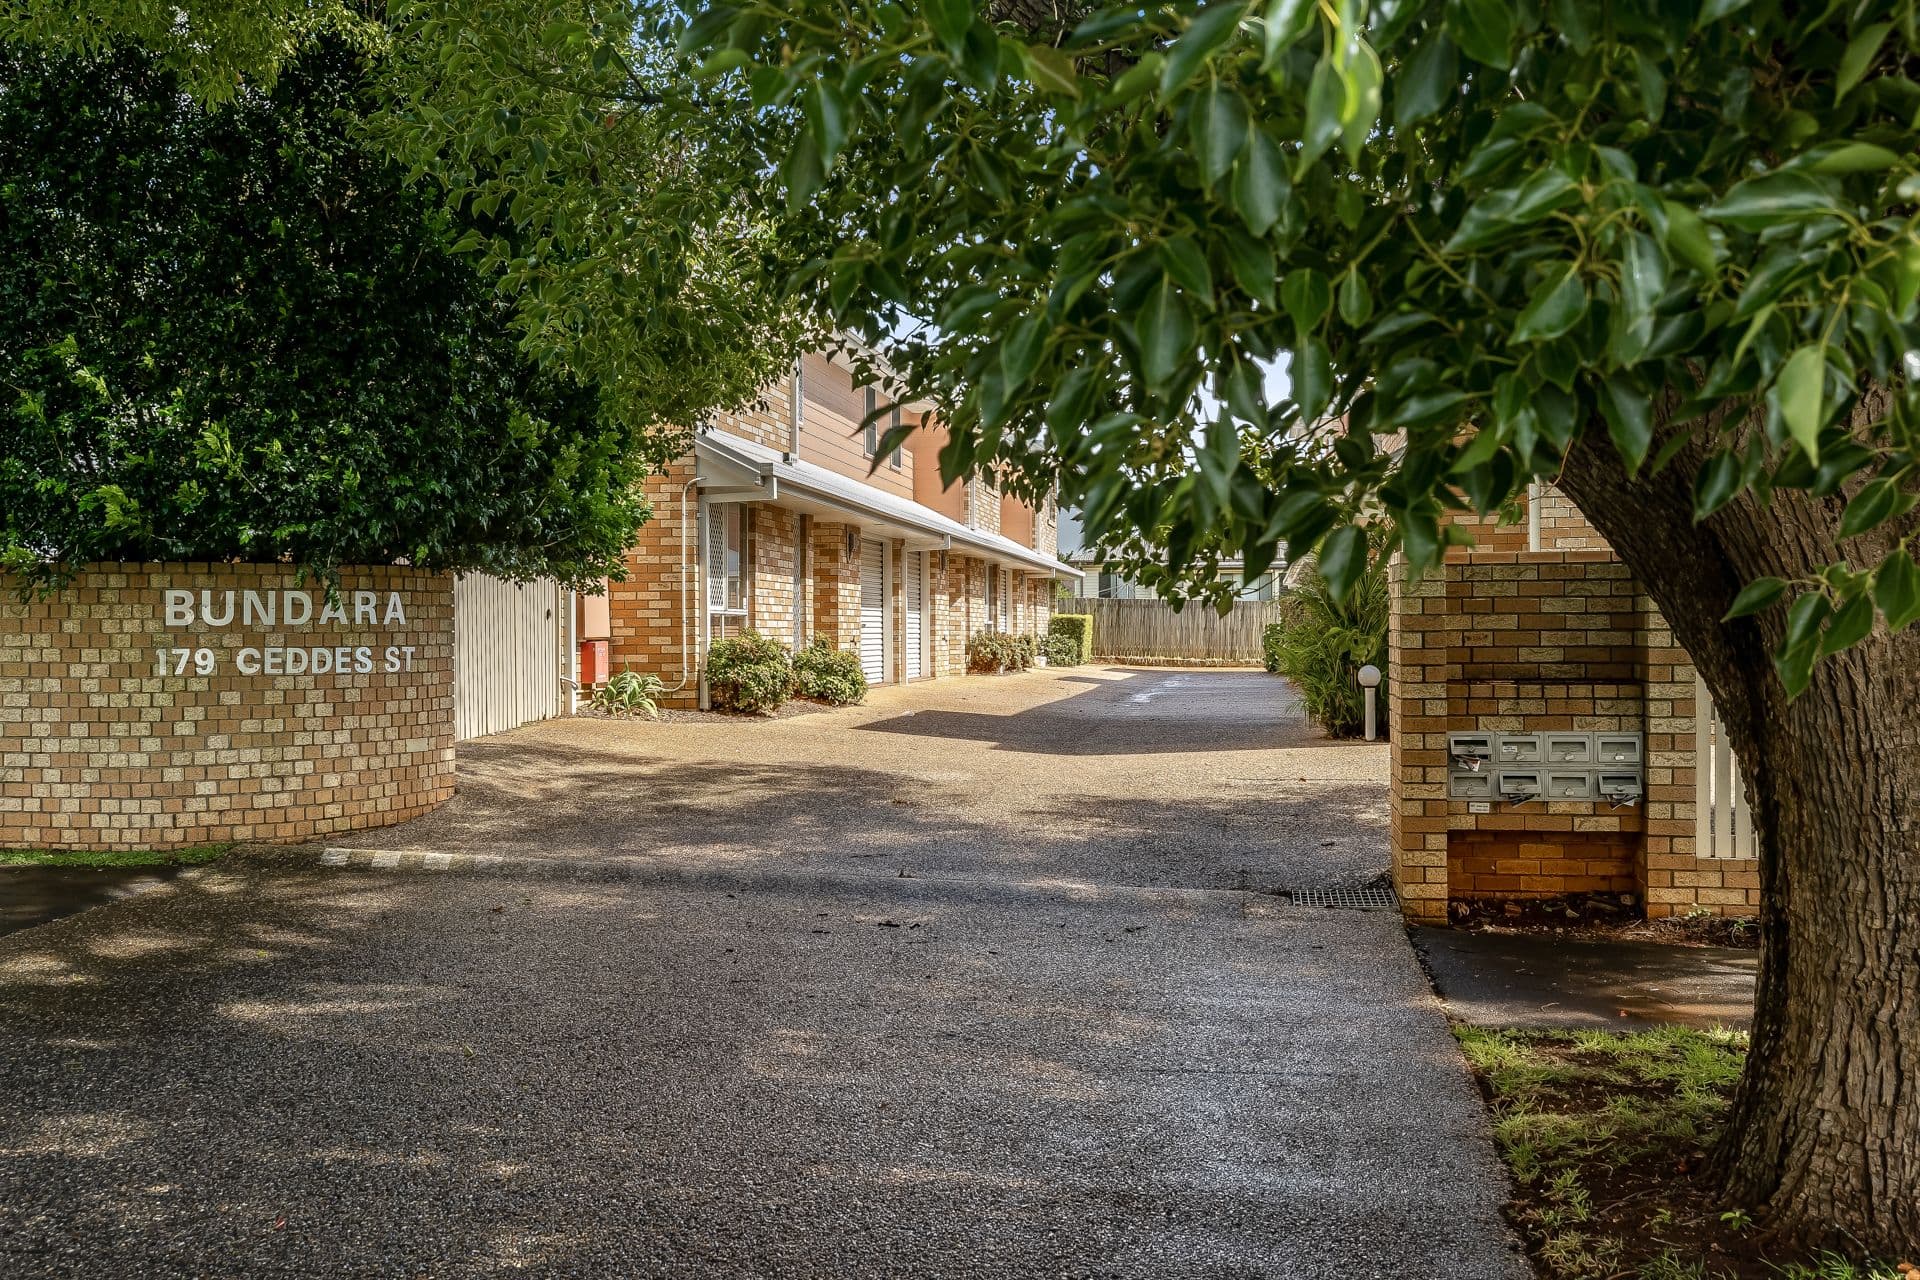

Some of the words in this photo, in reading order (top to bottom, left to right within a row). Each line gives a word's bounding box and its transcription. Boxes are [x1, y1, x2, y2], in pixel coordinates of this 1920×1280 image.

[165, 590, 406, 626] BUNDARA
[155, 649, 215, 676] 179
[384, 646, 416, 673] ST
